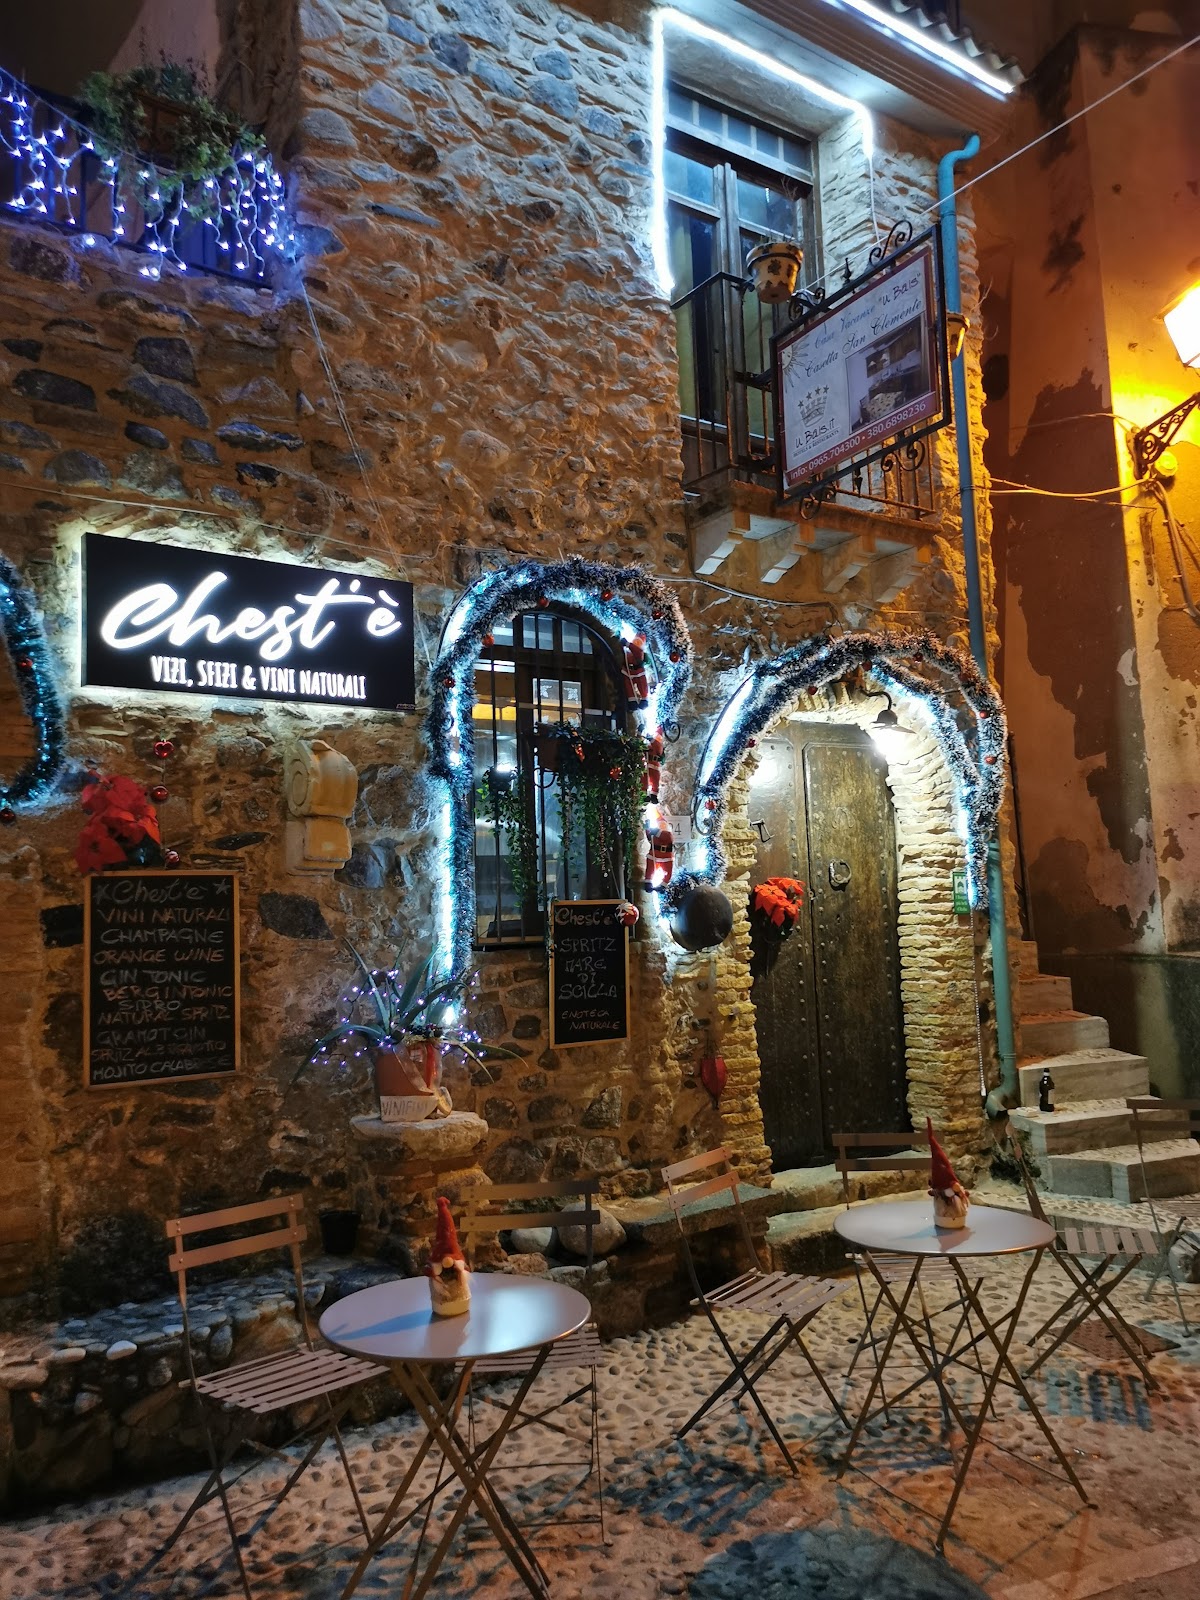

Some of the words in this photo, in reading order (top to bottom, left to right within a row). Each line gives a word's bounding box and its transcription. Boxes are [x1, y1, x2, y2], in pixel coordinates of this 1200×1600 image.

[805, 351, 838, 377] Casetta
[842, 329, 866, 355] San
[870, 299, 922, 336] Clemente
[791, 466, 808, 480] info:
[808, 436, 860, 471] 0965.704300
[867, 402, 926, 439] 380.6898236
[197, 659, 237, 689] SFIZI
[242, 666, 257, 691] &
[260, 667, 296, 693] VINI
[300, 670, 367, 700] NATURALI
[97, 908, 144, 924] VINI
[101, 928, 224, 944] CHAMPAGNE
[560, 937, 617, 953] SPRITZ
[93, 949, 166, 964] ORANGE
[174, 947, 225, 962] WINE
[565, 956, 607, 973] MARE
[100, 968, 138, 985] GIN
[142, 970, 208, 984] TONIC
[577, 972, 597, 984] DI
[559, 983, 618, 1000] SCILLA
[118, 1000, 181, 1012] SIDRO
[561, 1010, 610, 1020] ENOTECA
[569, 1021, 621, 1031] NATURALE
[93, 1063, 147, 1080] MOJITO
